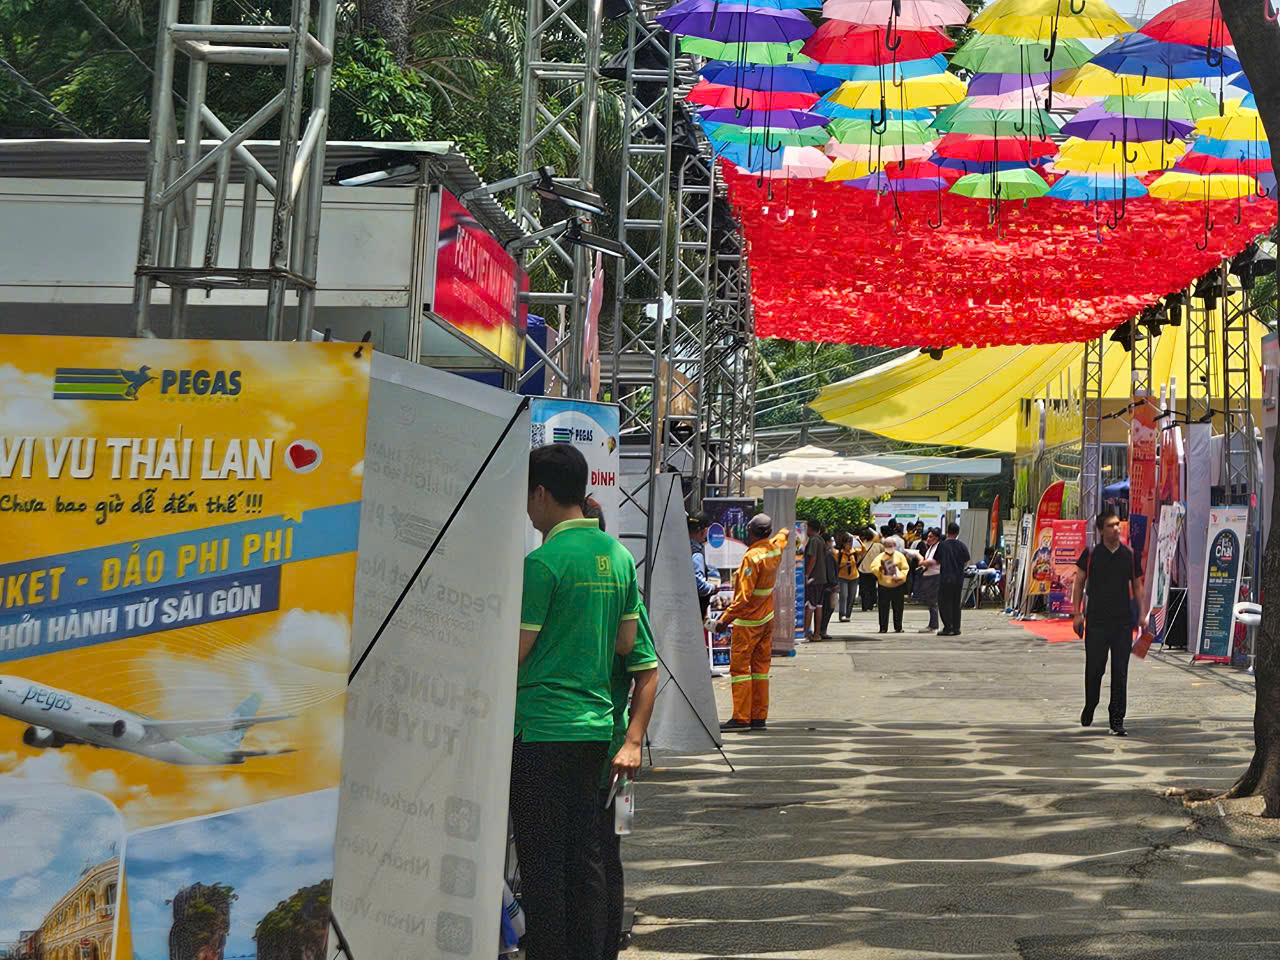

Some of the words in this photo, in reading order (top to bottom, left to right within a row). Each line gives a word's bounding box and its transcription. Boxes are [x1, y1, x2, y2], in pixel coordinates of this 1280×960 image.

[160, 369, 242, 396] PEGAS
[575, 429, 593, 441] PEGAS
[0, 437, 37, 479] VI
[44, 437, 97, 479] VU
[201, 438, 275, 480] LAN
[0, 493, 46, 513] Chưa
[56, 494, 87, 513] bao
[95, 493, 125, 525] giờ
[130, 487, 157, 514] dễ
[206, 489, 243, 514] thế
[246, 493, 263, 514] !!!
[0, 566, 66, 610] KET
[100, 543, 165, 592] ĐẢO
[177, 537, 231, 578] PHI
[243, 527, 294, 568] PHI
[0, 613, 41, 651] HỞI
[47, 608, 118, 643] HÀNH
[126, 596, 159, 629] TỪ
[161, 589, 202, 624] SÀI
[210, 581, 261, 616] GÒN
[22, 685, 72, 711] pegas
